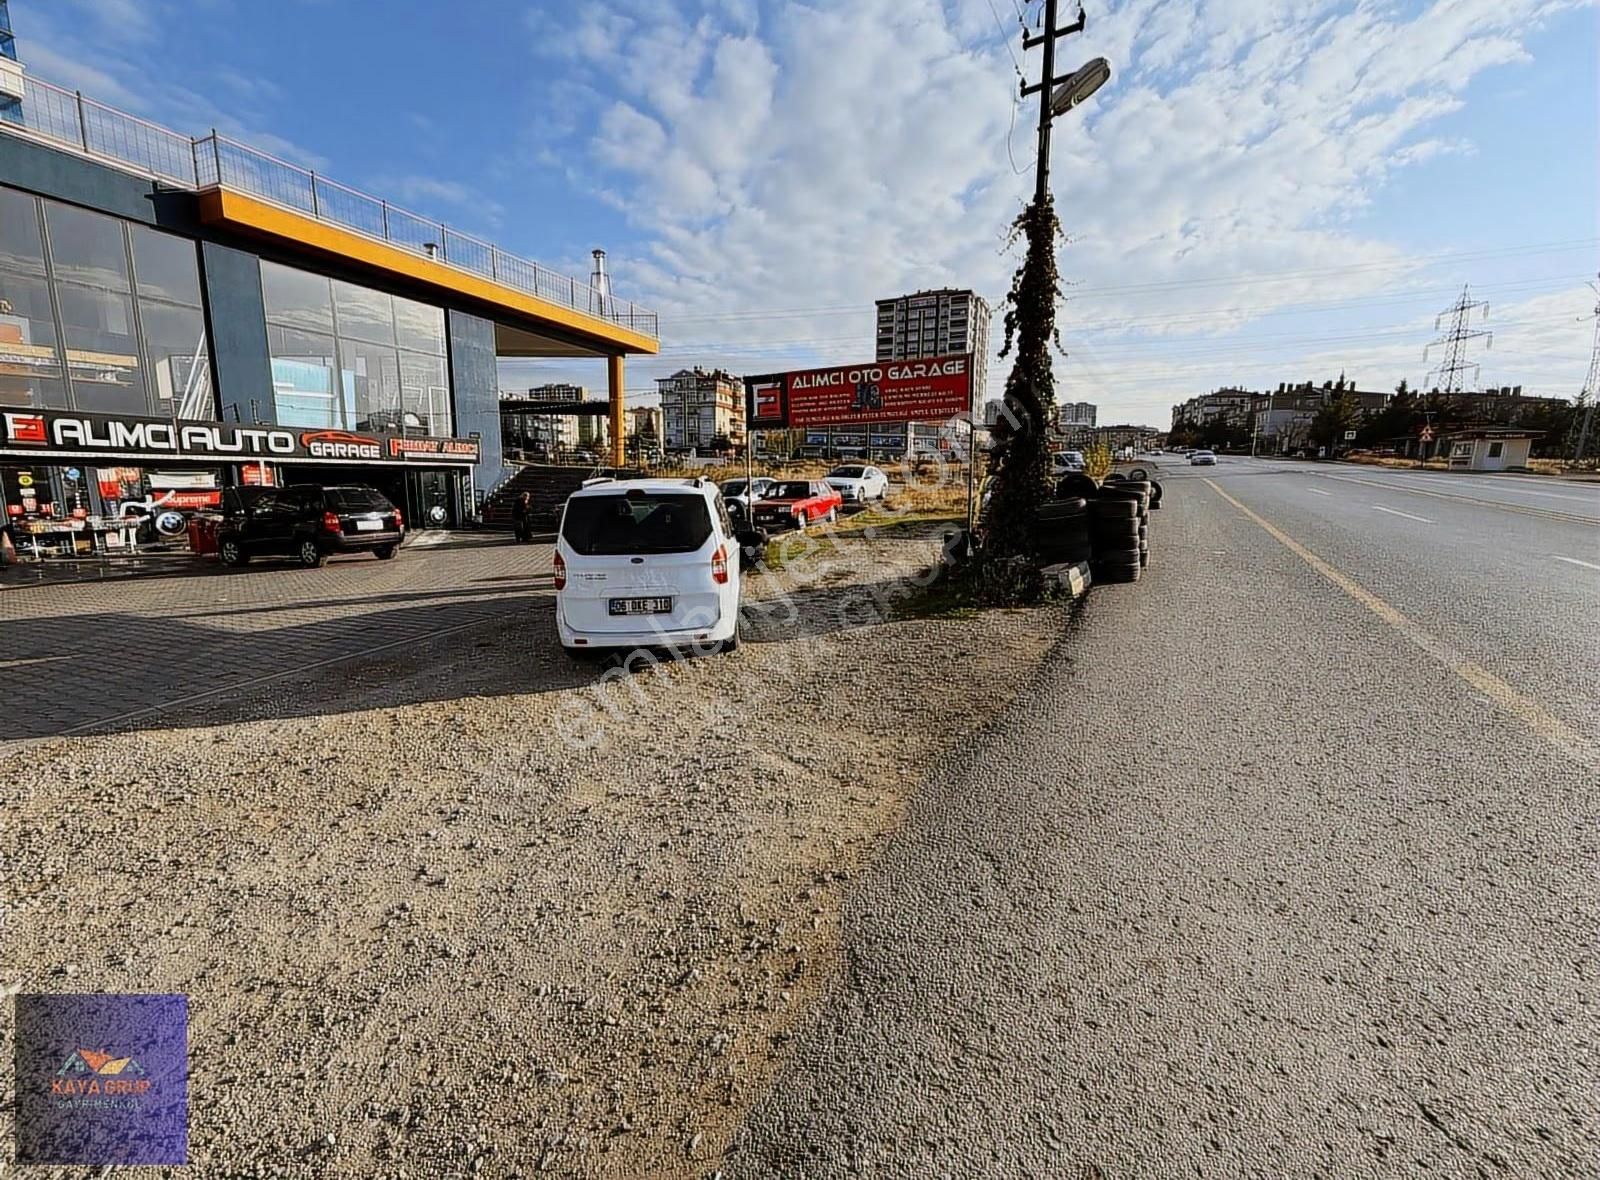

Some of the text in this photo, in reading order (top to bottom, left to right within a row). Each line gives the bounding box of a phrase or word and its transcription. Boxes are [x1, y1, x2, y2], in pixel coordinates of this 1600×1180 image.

[792, 360, 965, 389] ALIMCI OTO GARAGE
[53, 418, 295, 453] ALIMCI AUTO
[310, 441, 381, 458] GARAGE
